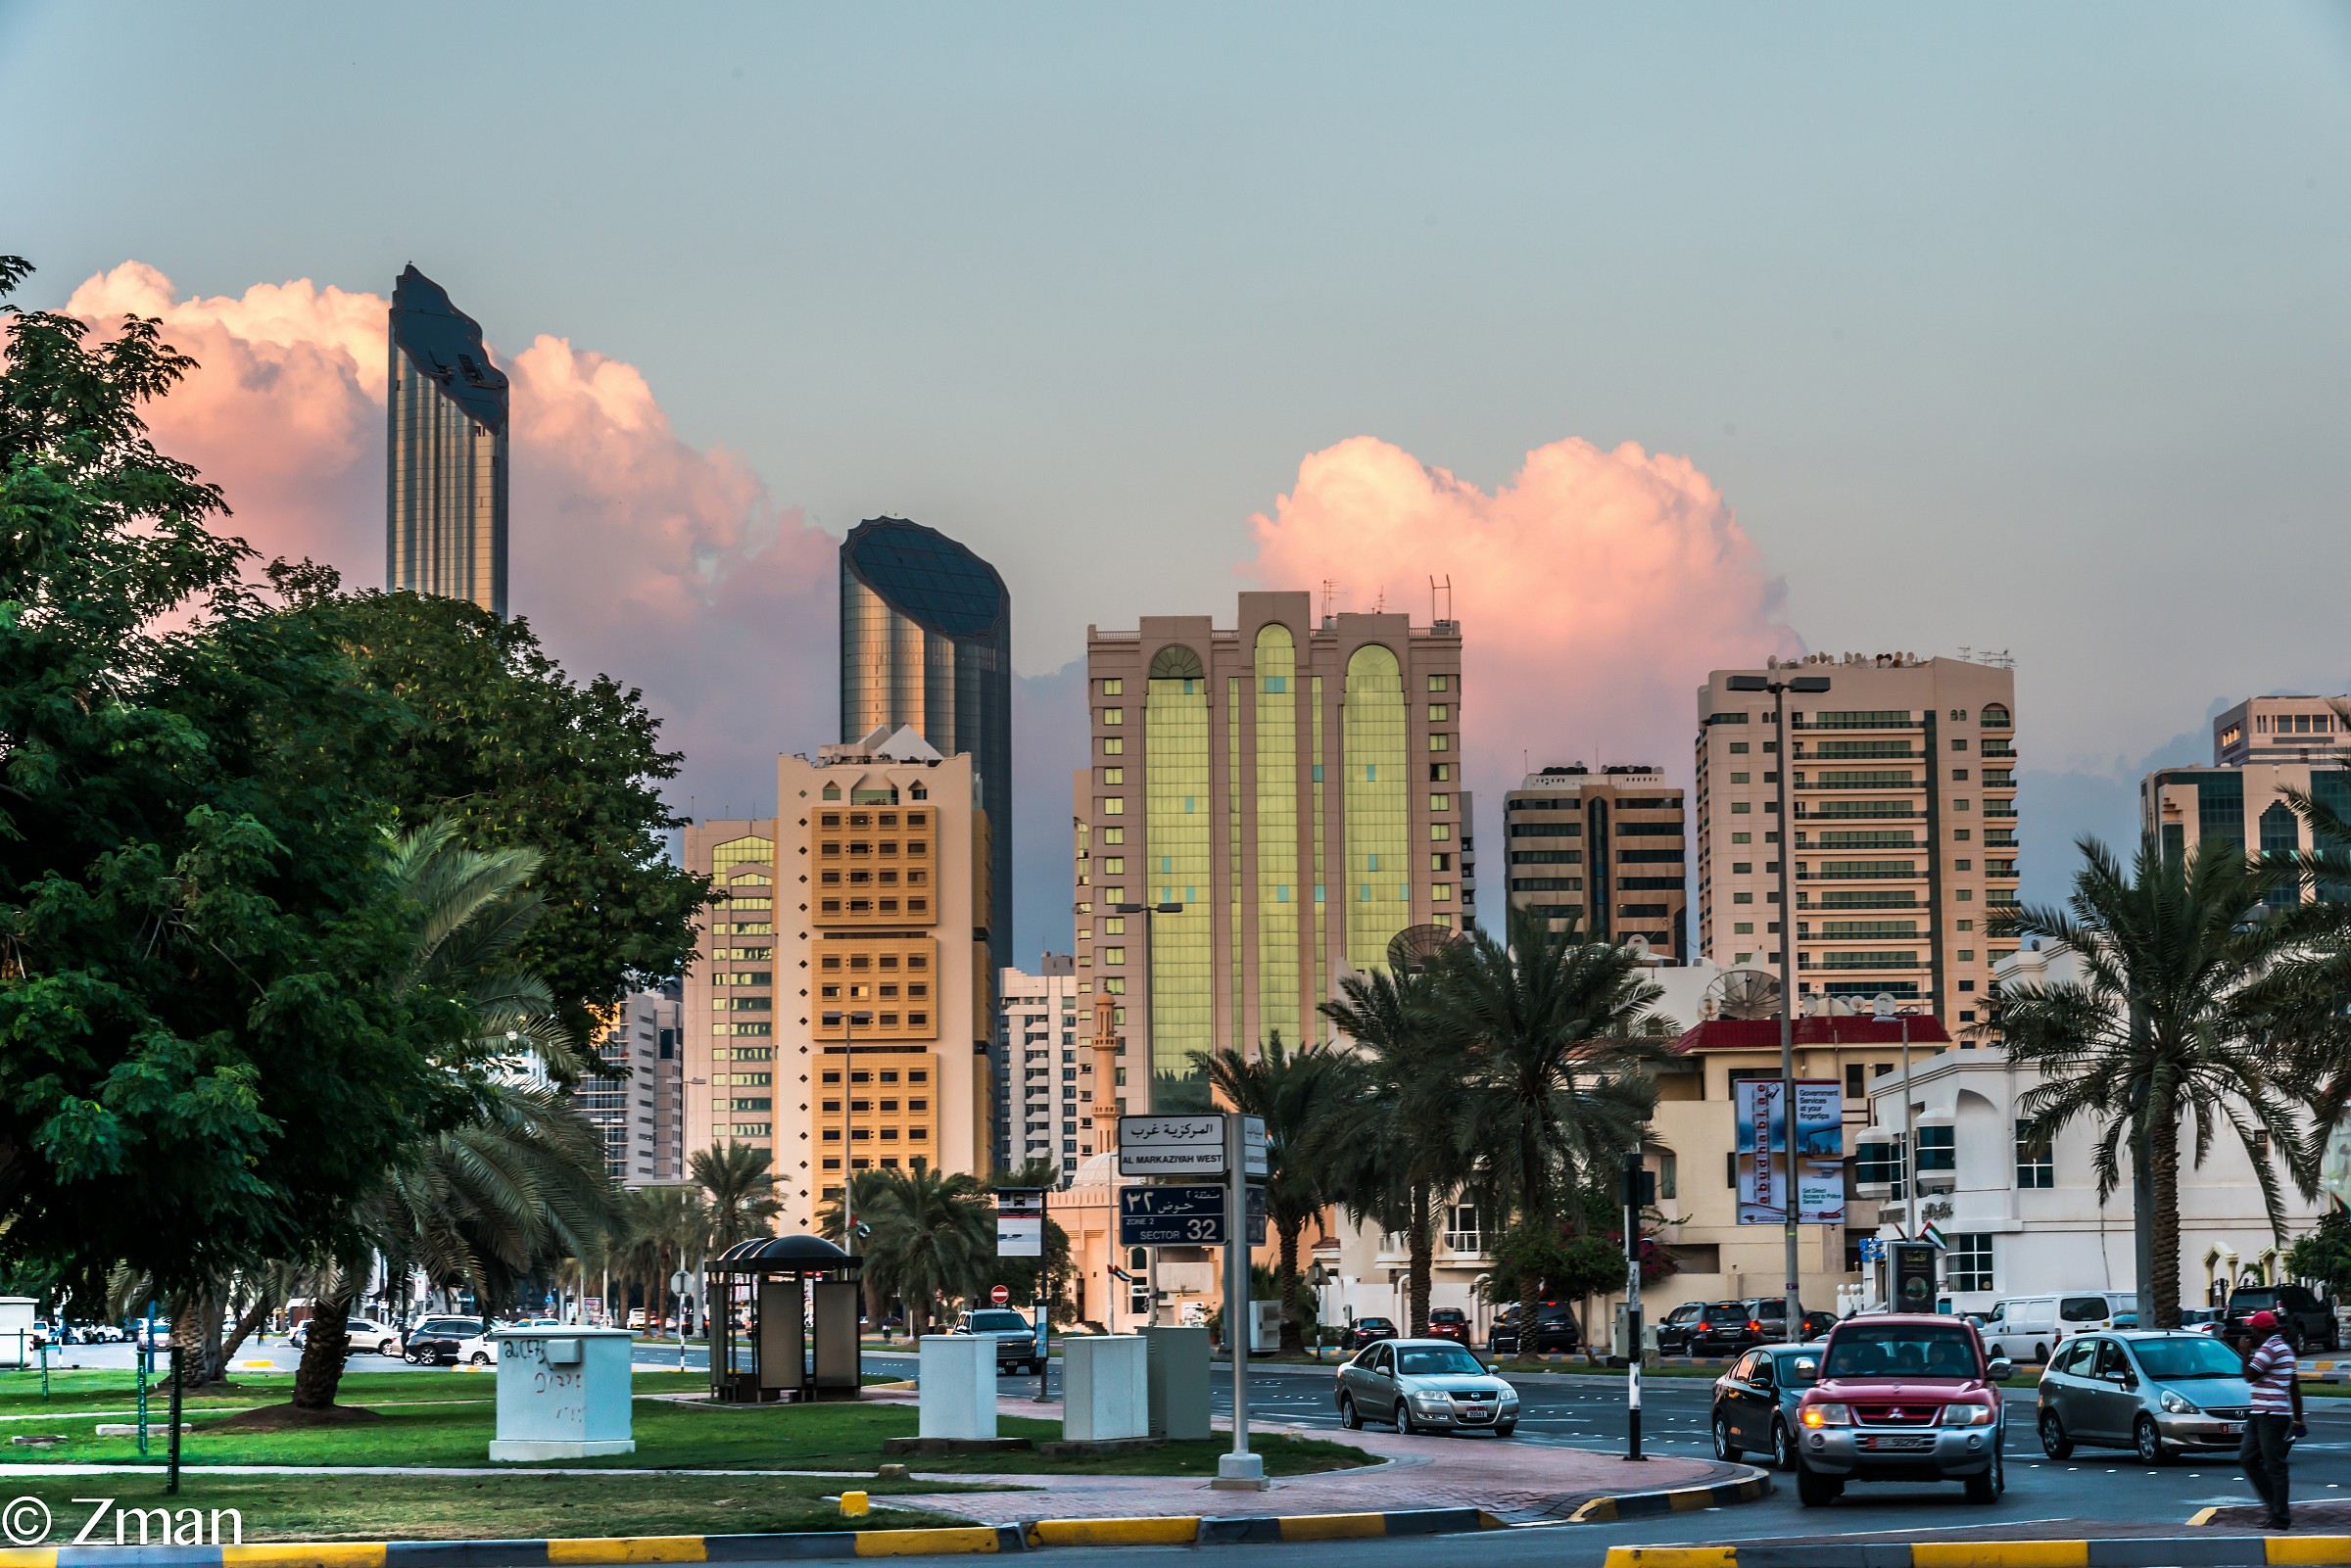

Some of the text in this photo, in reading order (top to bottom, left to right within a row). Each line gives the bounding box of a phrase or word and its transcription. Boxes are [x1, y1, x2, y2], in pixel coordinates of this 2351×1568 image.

[1130, 1123, 1213, 1139] المركزية غرب
[1136, 1156, 1194, 1164] MARKAZIYAH
[1127, 1192, 1194, 1213] حوض ٣٢
[1140, 1219, 1217, 1240] SECTOR 32
